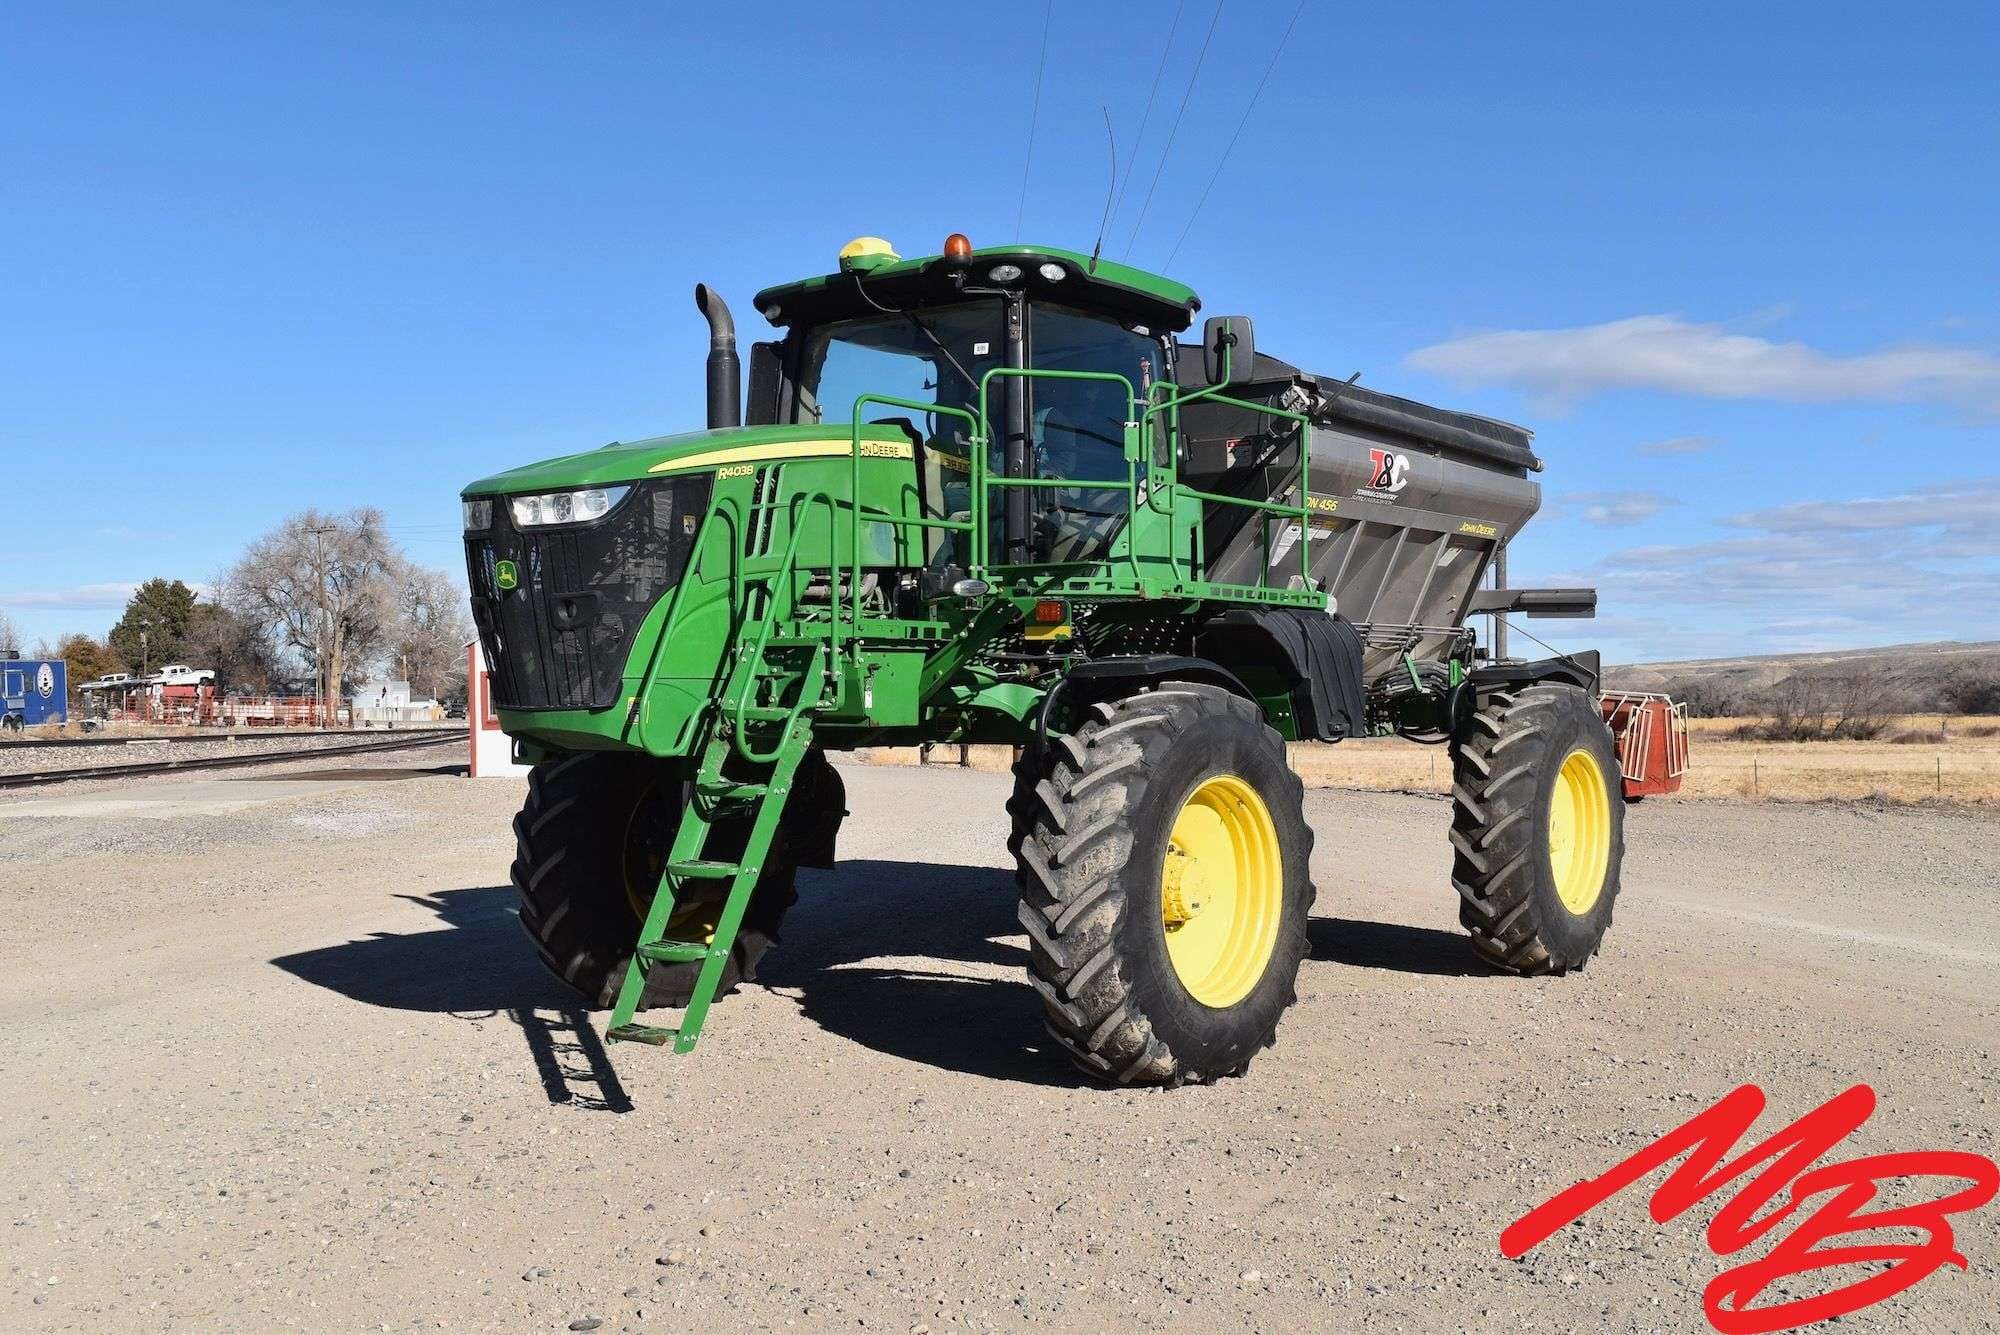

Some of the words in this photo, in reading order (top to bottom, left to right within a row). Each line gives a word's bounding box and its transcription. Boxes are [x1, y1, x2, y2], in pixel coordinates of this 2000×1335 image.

[872, 442, 899, 456] DEERE
[718, 465, 754, 480] R4038
[1319, 499, 1338, 511] 456
[1459, 521, 1477, 533] JOHN
[1477, 523, 1497, 536] DEERE
